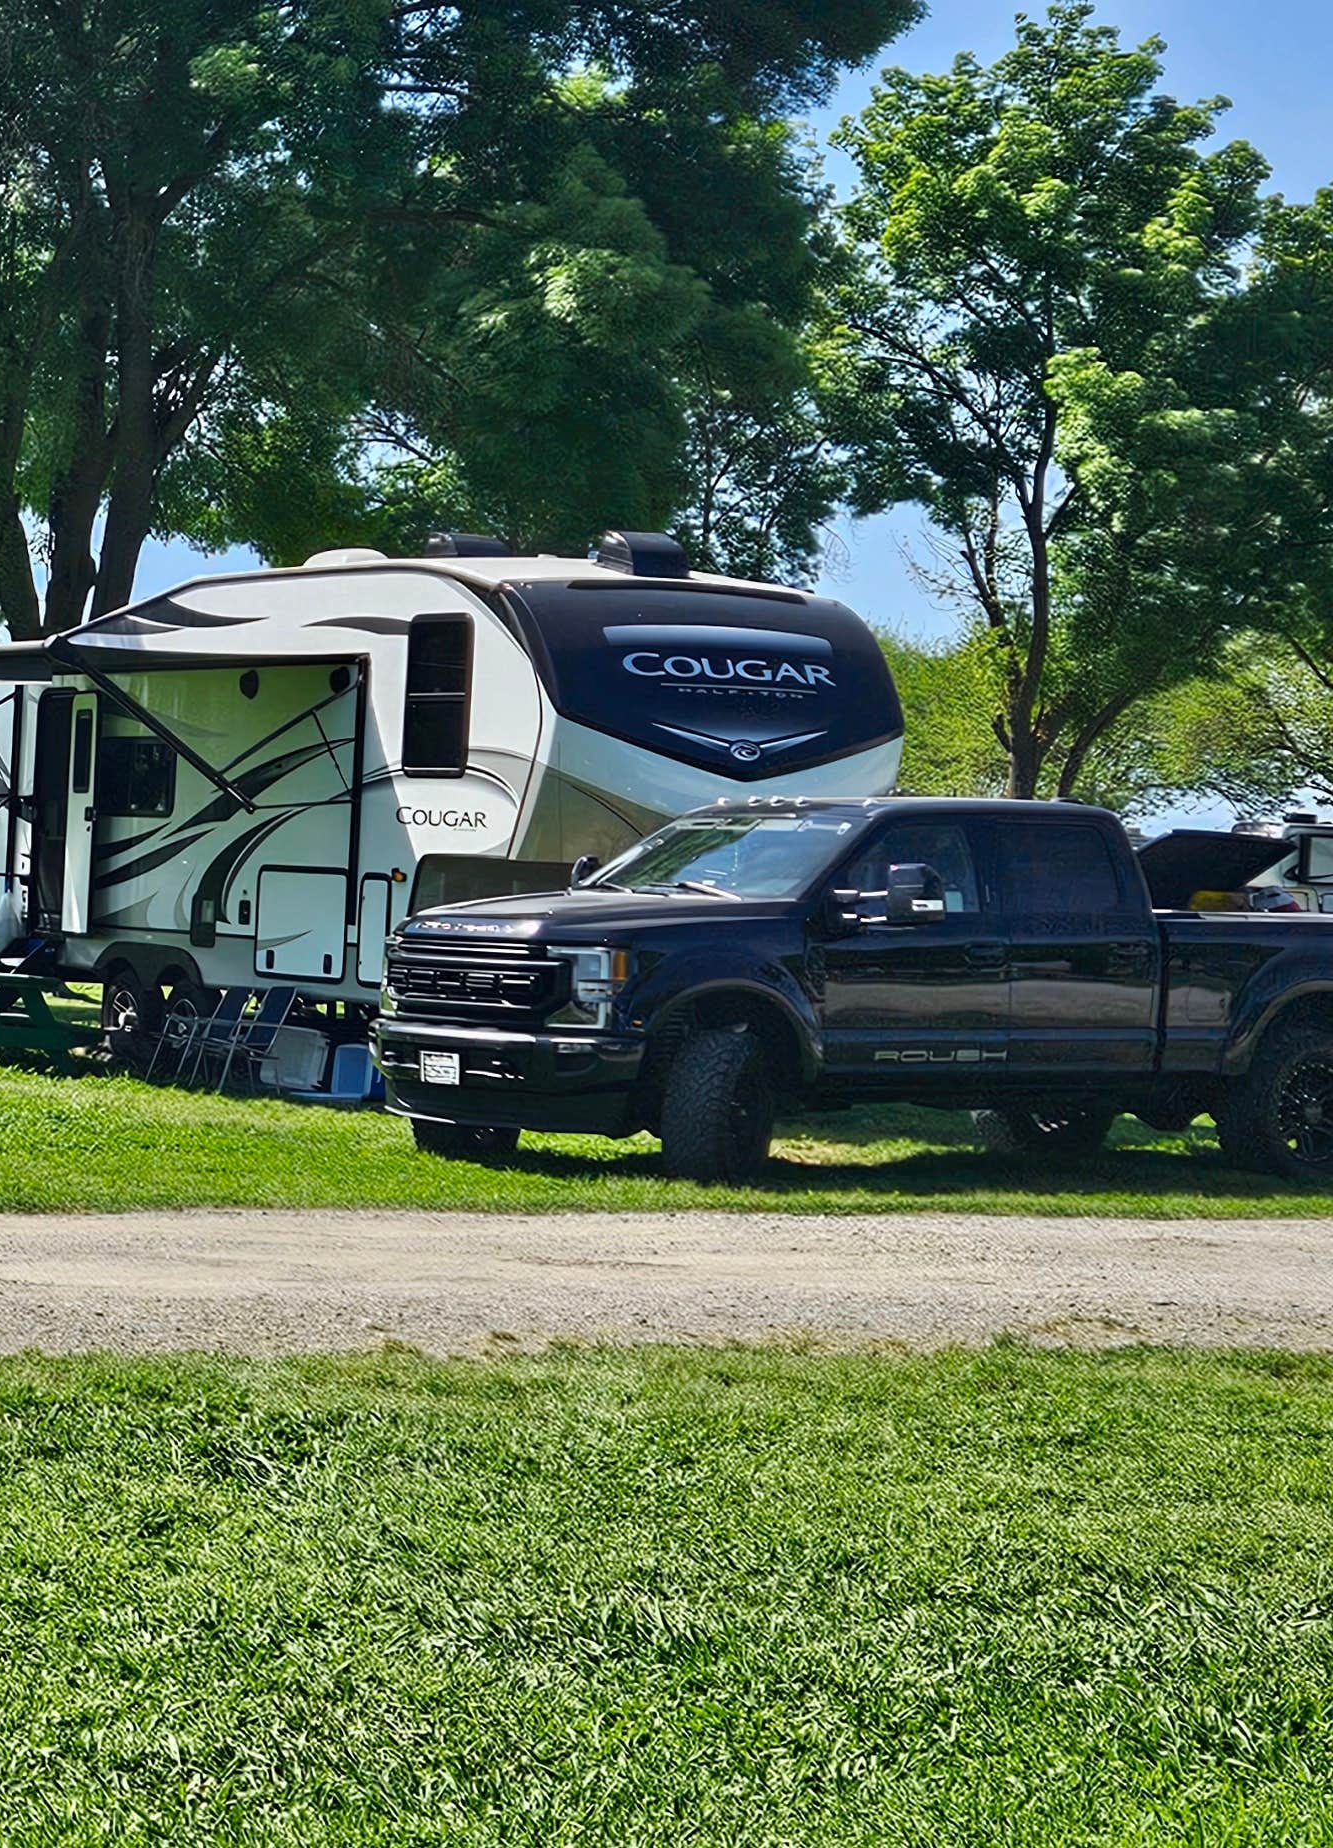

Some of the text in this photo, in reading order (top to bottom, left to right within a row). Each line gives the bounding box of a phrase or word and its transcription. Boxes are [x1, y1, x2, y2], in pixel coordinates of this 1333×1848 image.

[622, 652, 837, 687] COUGAR
[396, 806, 488, 829] COUGAR
[875, 1049, 1007, 1062] ROUSH
